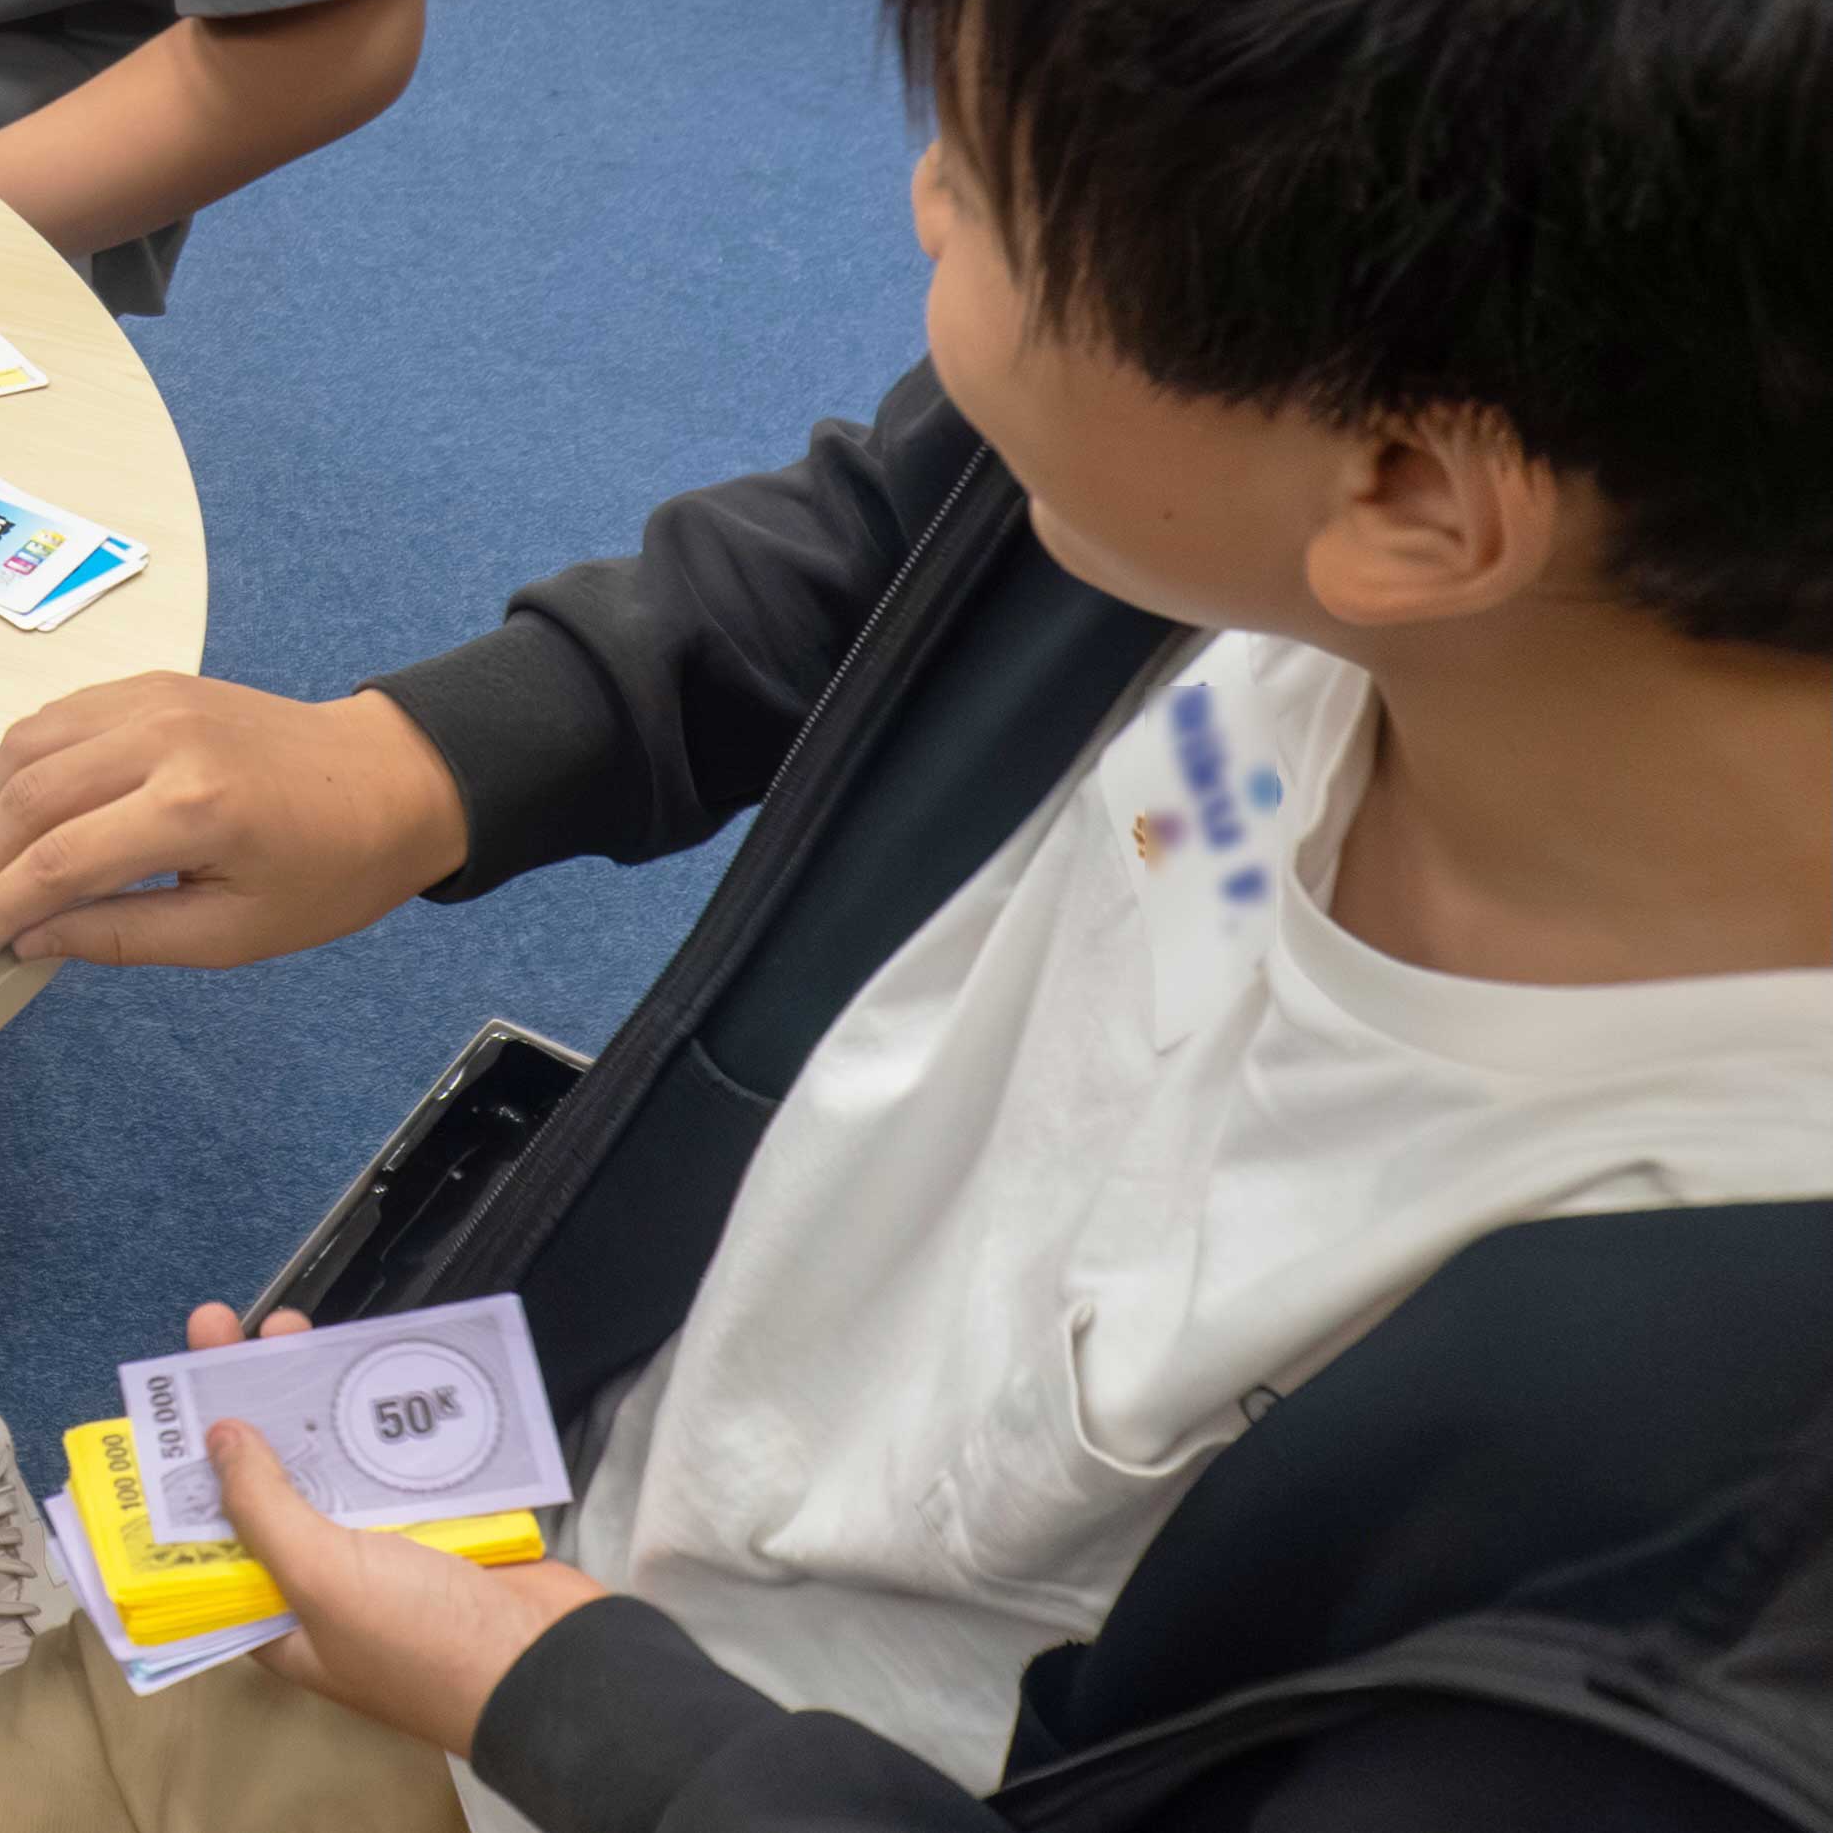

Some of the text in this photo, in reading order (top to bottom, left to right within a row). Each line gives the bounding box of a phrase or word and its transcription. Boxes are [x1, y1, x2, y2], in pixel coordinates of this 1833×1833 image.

[146, 1375, 186, 1460] 50 000
[372, 1383, 464, 1445] 50K
[101, 1434, 143, 1512] 100 000
